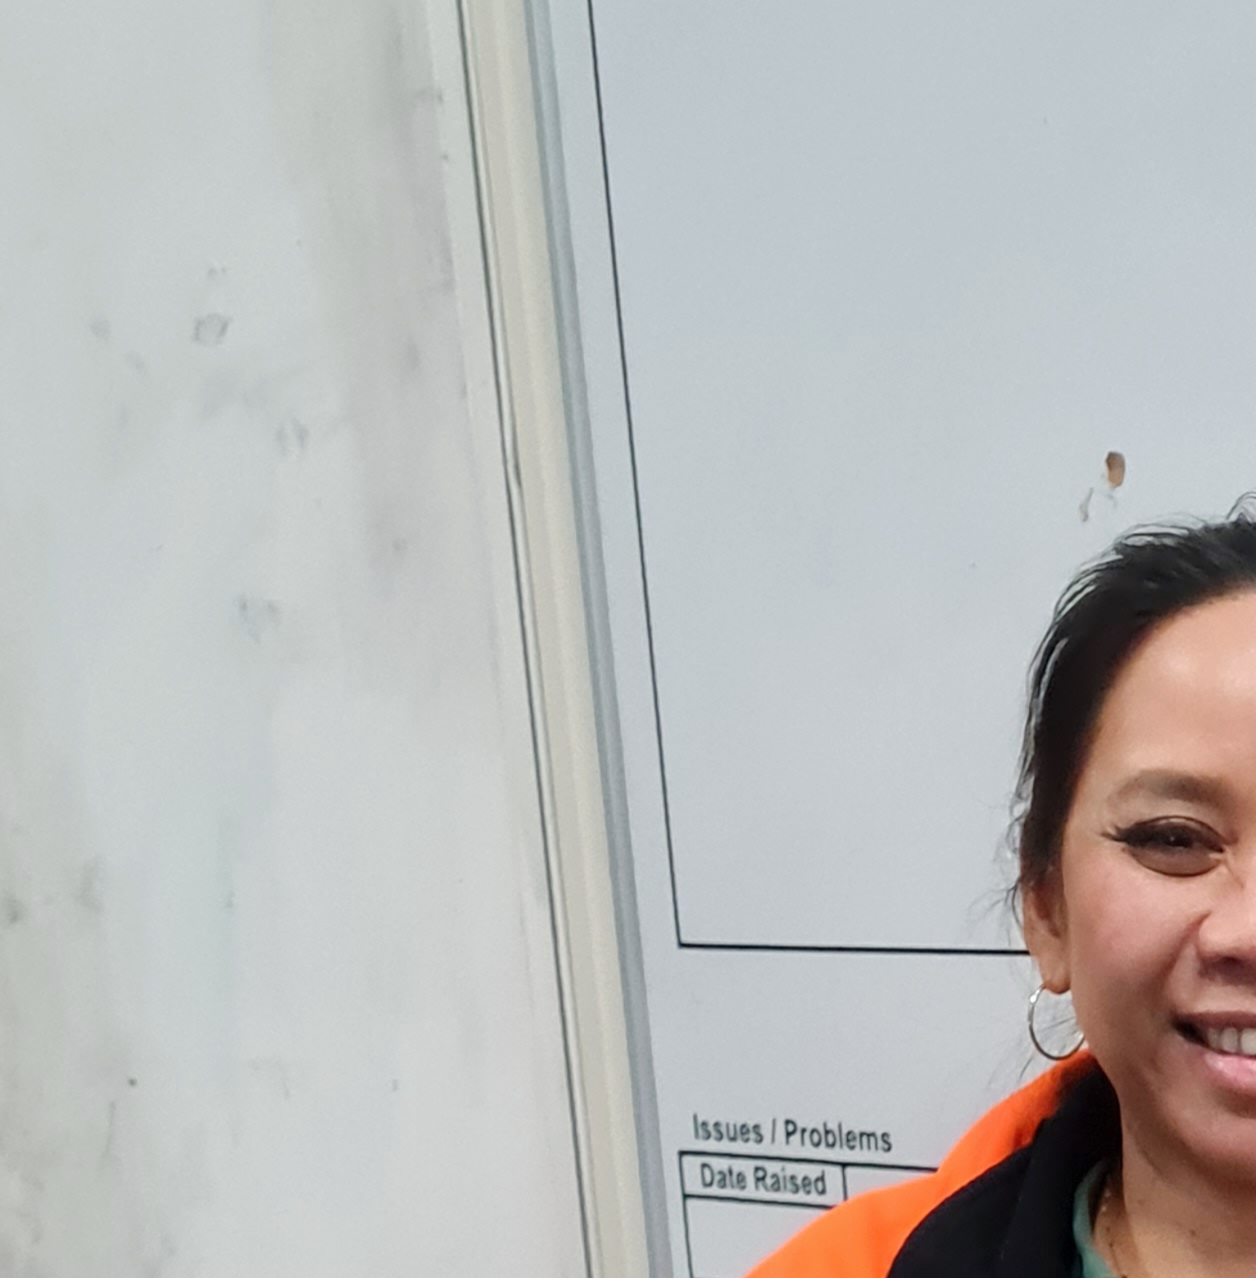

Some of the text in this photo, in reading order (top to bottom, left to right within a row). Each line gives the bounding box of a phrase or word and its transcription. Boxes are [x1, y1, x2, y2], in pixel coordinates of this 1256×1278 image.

[693, 1113, 892, 1152] Issues / Problems
[700, 1162, 827, 1196] Date Raised
